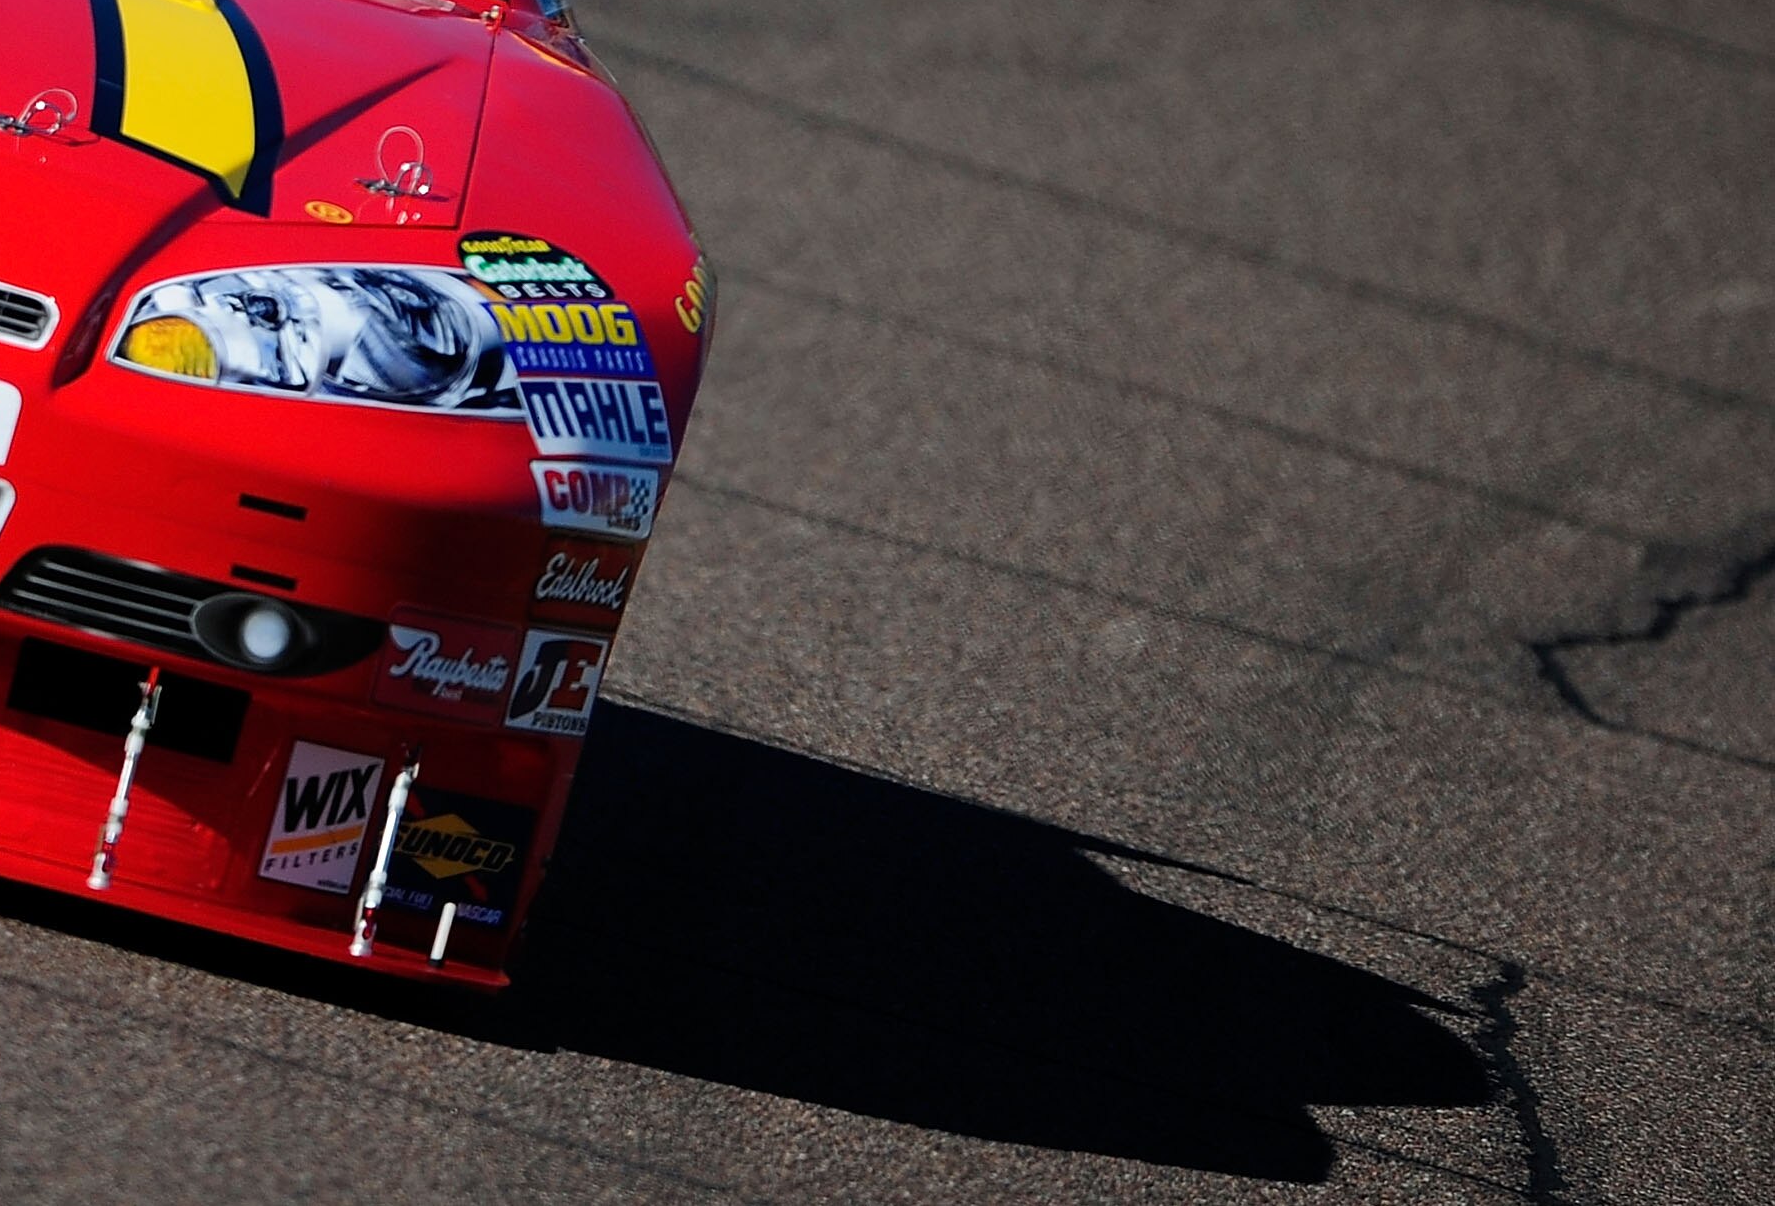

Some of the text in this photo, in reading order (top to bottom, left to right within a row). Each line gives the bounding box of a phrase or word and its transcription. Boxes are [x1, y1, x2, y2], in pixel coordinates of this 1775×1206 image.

[496, 282, 608, 300] BELTS
[489, 302, 639, 347] MOOG
[515, 345, 588, 370] CHASSIS
[519, 381, 668, 445] MAHLE
[542, 469, 631, 517] COMP
[535, 551, 629, 611] Edelbrock
[389, 624, 511, 695] Raybestos
[510, 639, 604, 720] JE
[282, 763, 382, 833] WIX
[262, 843, 359, 872] FILTERS
